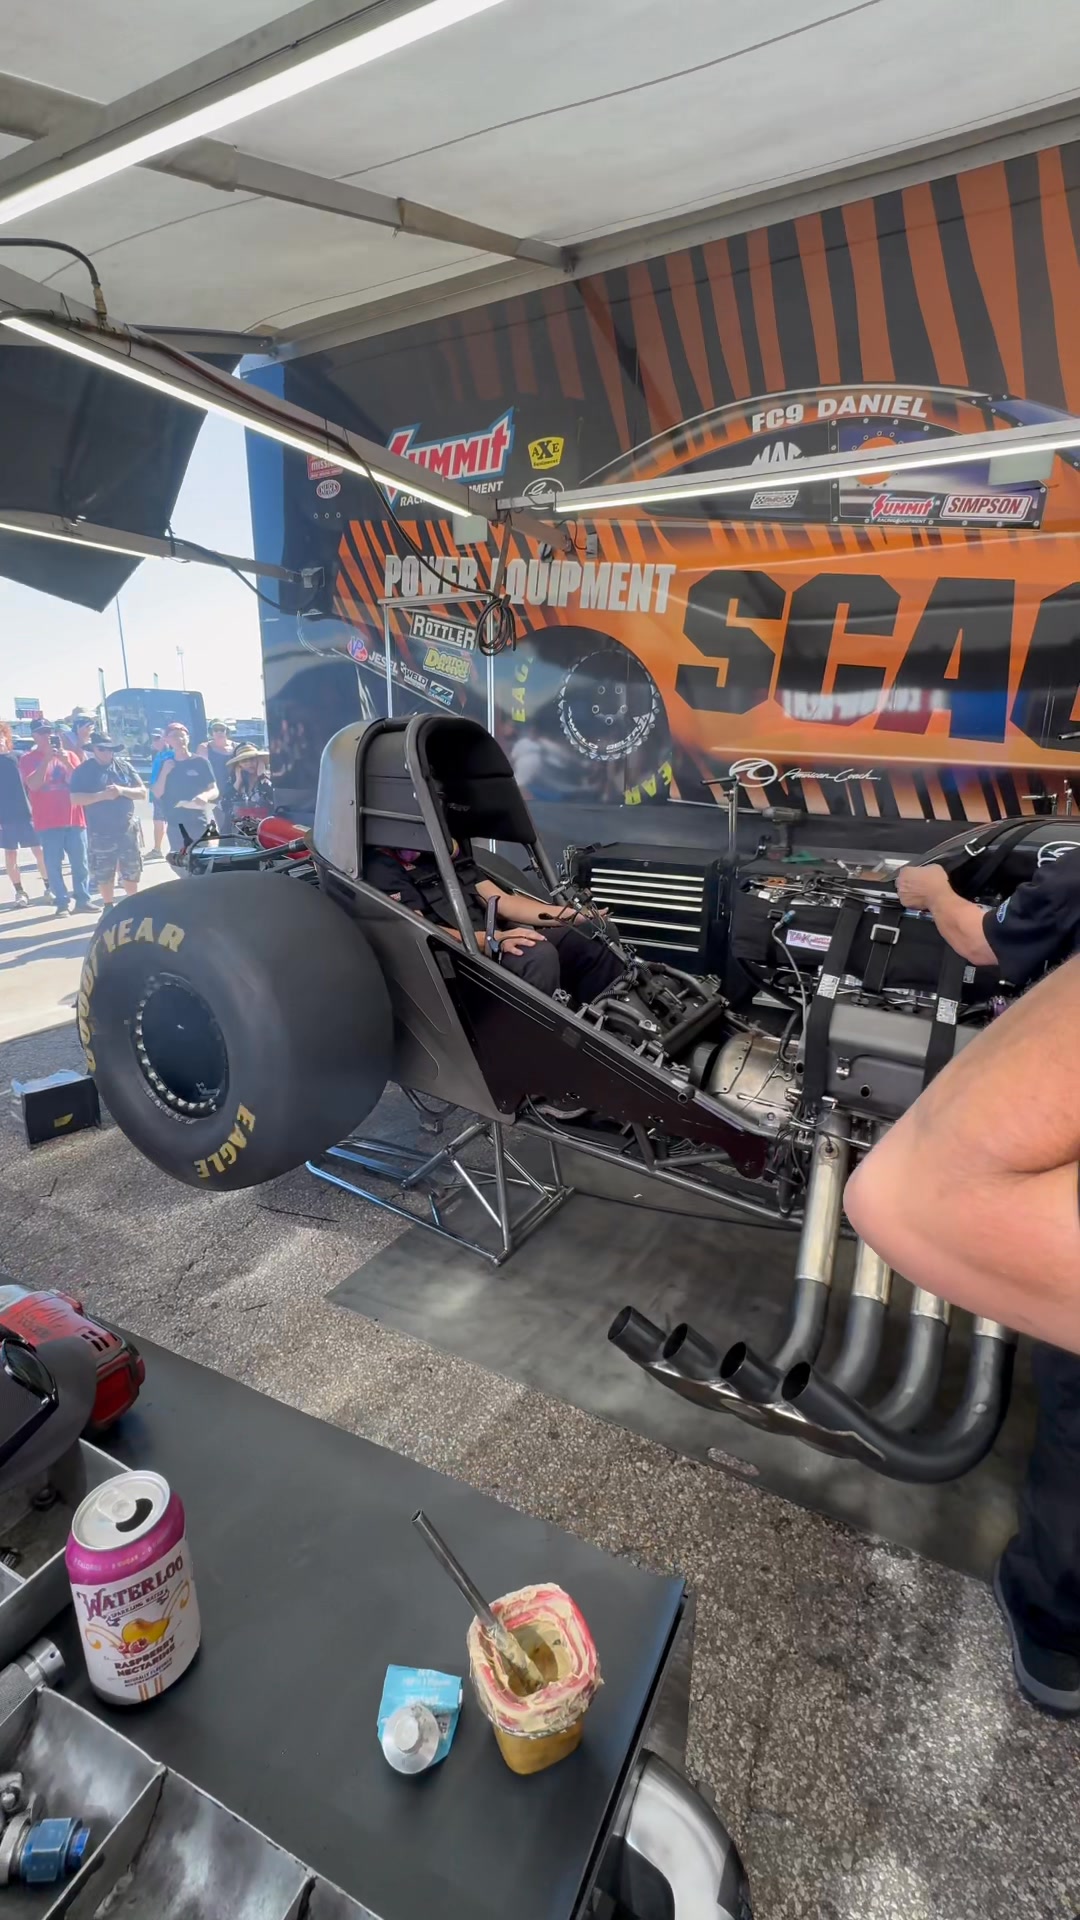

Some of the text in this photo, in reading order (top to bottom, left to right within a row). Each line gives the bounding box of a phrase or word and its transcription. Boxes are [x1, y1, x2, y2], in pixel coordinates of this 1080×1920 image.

[752, 394, 928, 433] FC9 DANIEL
[531, 440, 560, 460] AXE
[871, 493, 937, 519] SUMMIT
[947, 497, 1023, 515] SIMPSON
[384, 554, 479, 598] POWER
[412, 613, 477, 650] ROTTLER
[404, 668, 429, 686] WELD
[778, 767, 879, 783] American Coach
[193, 1102, 256, 1178] EAGLE
[76, 1554, 184, 1621] WATERLOO
[114, 1635, 175, 1669] RASPBERRY
[116, 1643, 176, 1677] NECTARINE
